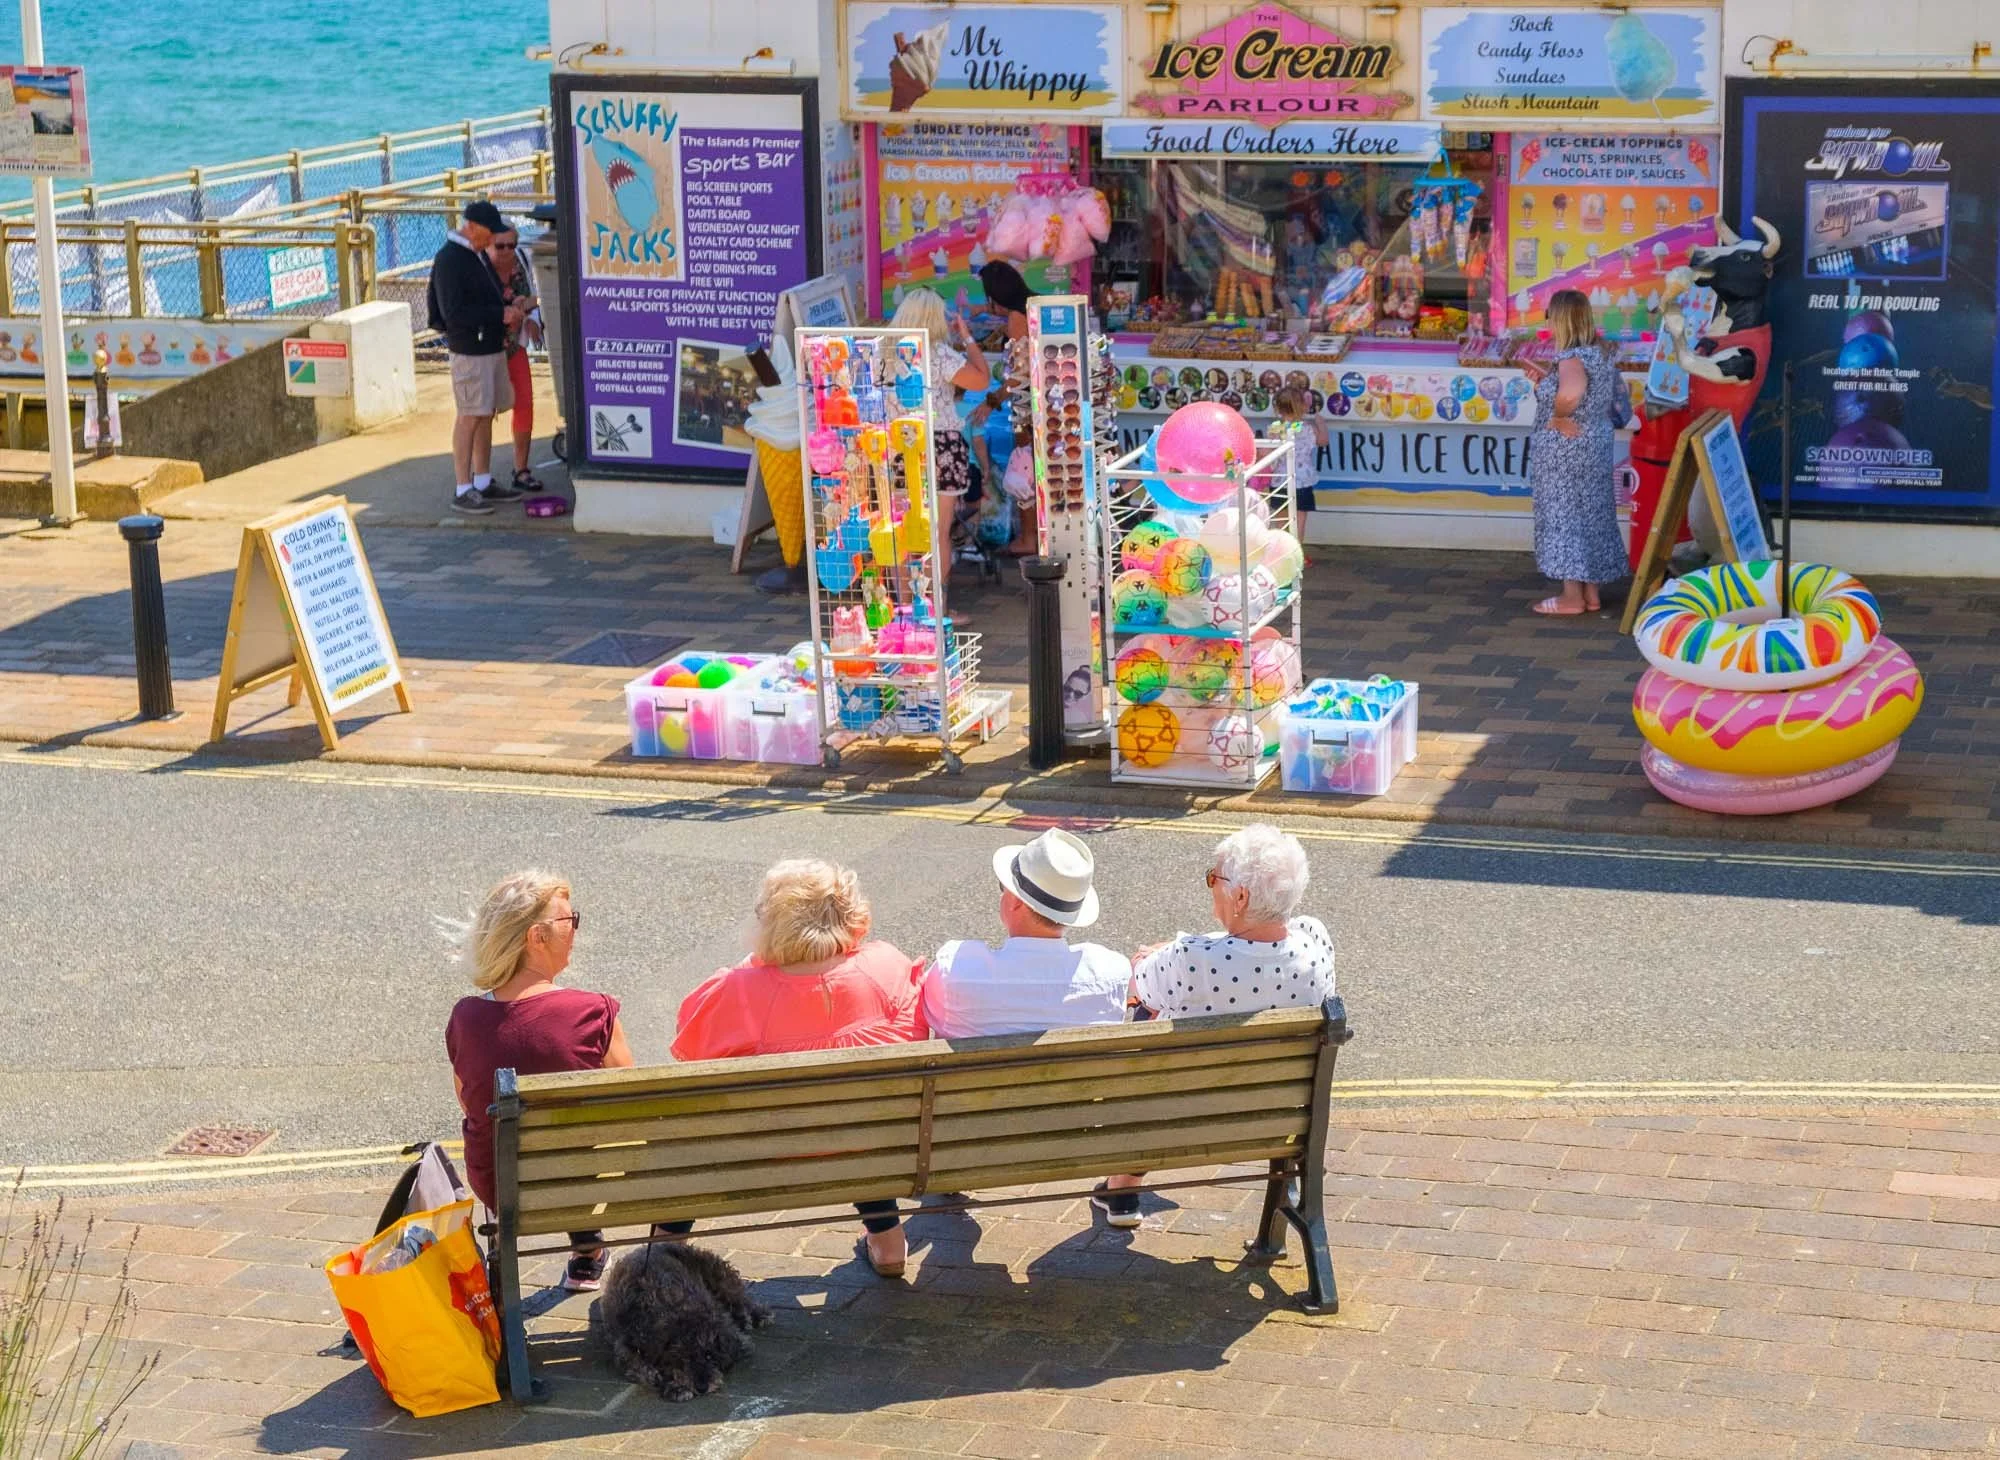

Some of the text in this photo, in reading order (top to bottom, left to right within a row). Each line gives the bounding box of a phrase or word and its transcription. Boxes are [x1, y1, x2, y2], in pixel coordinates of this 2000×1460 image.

[1256, 13, 1278, 22] THE
[1509, 15, 1553, 33] Rock
[950, 25, 1003, 56] Mr
[1149, 30, 1391, 79] Ice Cream
[1477, 42, 1585, 62] Candy Floss
[964, 59, 1090, 102] Whippy
[1494, 67, 1566, 84] Sundaes
[1178, 98, 1359, 112] PARLOUR
[1461, 94, 1600, 111] Slush Mountain
[575, 98, 678, 145] SCRUFFY
[914, 125, 1031, 137] SUNDAE TOPPINGS
[681, 136, 800, 149] The Islands Premier
[1144, 126, 1400, 155] Food Orders Here
[1545, 138, 1683, 149] ICE-CREAM TOPPINGS
[684, 152, 796, 180] Sports Bar
[1562, 153, 1665, 166] NUTS, SPRINKLES,
[1543, 167, 1612, 178] CHOCOLATE
[1641, 168, 1686, 180] SAUCES
[686, 182, 772, 194] BIG SCREEN SPORTS
[687, 195, 742, 207] POOL TABLE
[687, 209, 751, 220] DARTS BOARD
[688, 222, 800, 236] WEDNESDAY QUIZ NIGHT
[590, 221, 675, 264] JACKS
[688, 236, 793, 249] LOYALTY CARD SCHEME
[689, 249, 758, 261] DAYTIME FOOD
[690, 263, 776, 275] LOW DRINKS PRICES
[690, 277, 734, 288] FREE WIFI
[585, 287, 776, 303] AVAILABLE FOR PRIVATE FUNCTION
[608, 301, 628, 312] ALL
[630, 302, 670, 313] SPORTS
[671, 303, 715, 314] SHOWN
[716, 304, 752, 316] WHEN
[1808, 294, 1840, 309] REAL
[1861, 295, 1883, 311] PIN
[1883, 296, 1941, 312] BOWLING
[665, 316, 697, 328] WITH
[699, 317, 720, 328] THE
[722, 318, 747, 329] BEST
[594, 340, 665, 354] £2.70 A PINT!
[590, 371, 670, 382] DURING ADVERTISED
[595, 383, 634, 393] FOOTBALL
[1833, 381, 1909, 392] GREAT FOR ALL AGES
[1316, 432, 1531, 478] AIRY ICE CREA
[1807, 447, 1933, 465] SANDOWN PIER
[284, 516, 336, 546] COLD DRINKS
[318, 565, 336, 577] MANY
[335, 669, 359, 685] PEANUT
